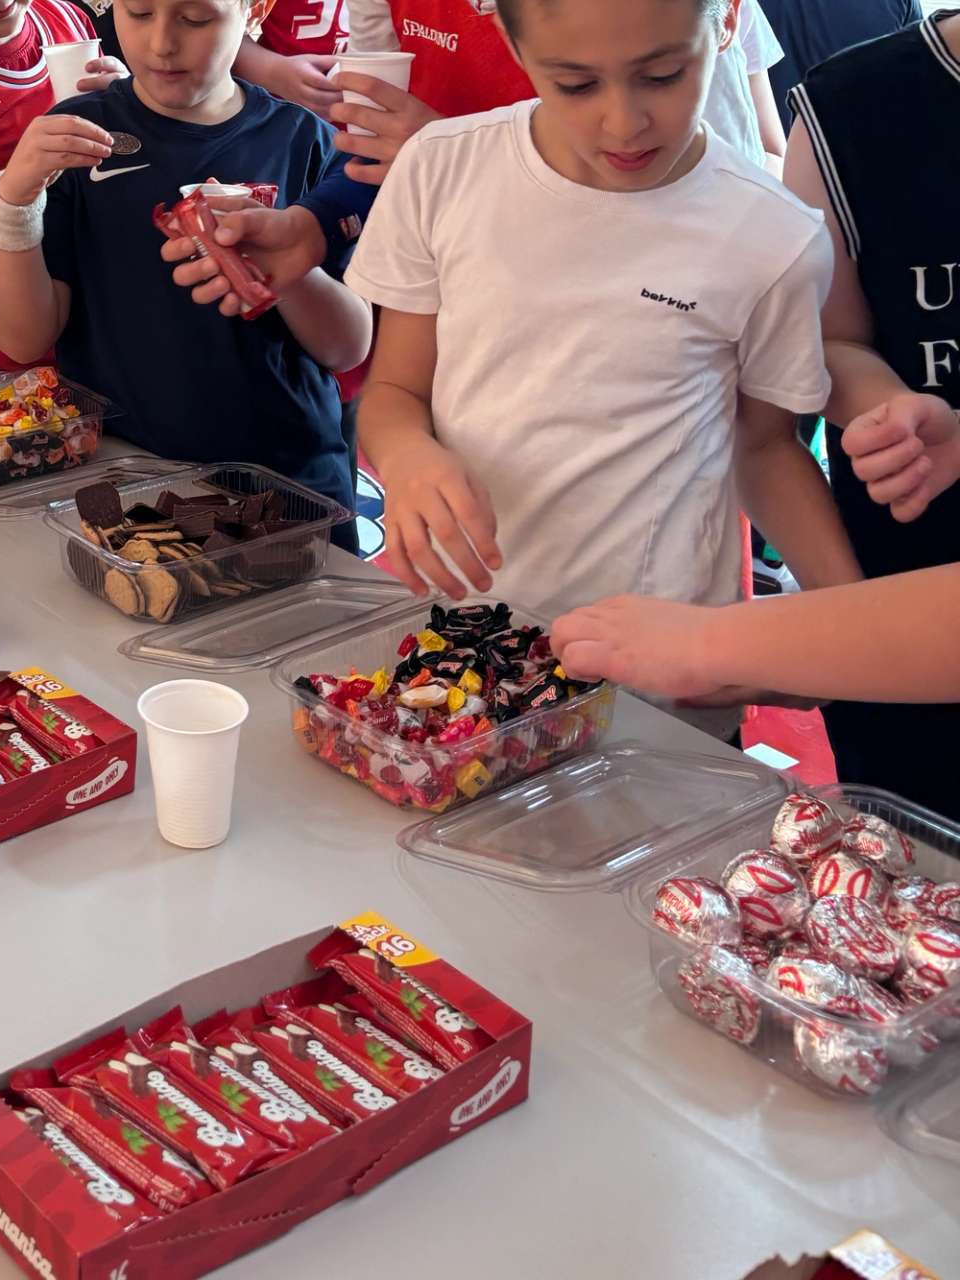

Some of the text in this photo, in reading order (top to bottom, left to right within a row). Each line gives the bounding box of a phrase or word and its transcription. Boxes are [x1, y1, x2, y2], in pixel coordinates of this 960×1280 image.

[402, 18, 459, 53] SPALDING
[34, 680, 63, 694] 16
[72, 765, 119, 802] ONE AND ONLY
[379, 934, 417, 958] 16
[147, 1070, 245, 1147] Bananica
[43, 1121, 136, 1206] Bananica
